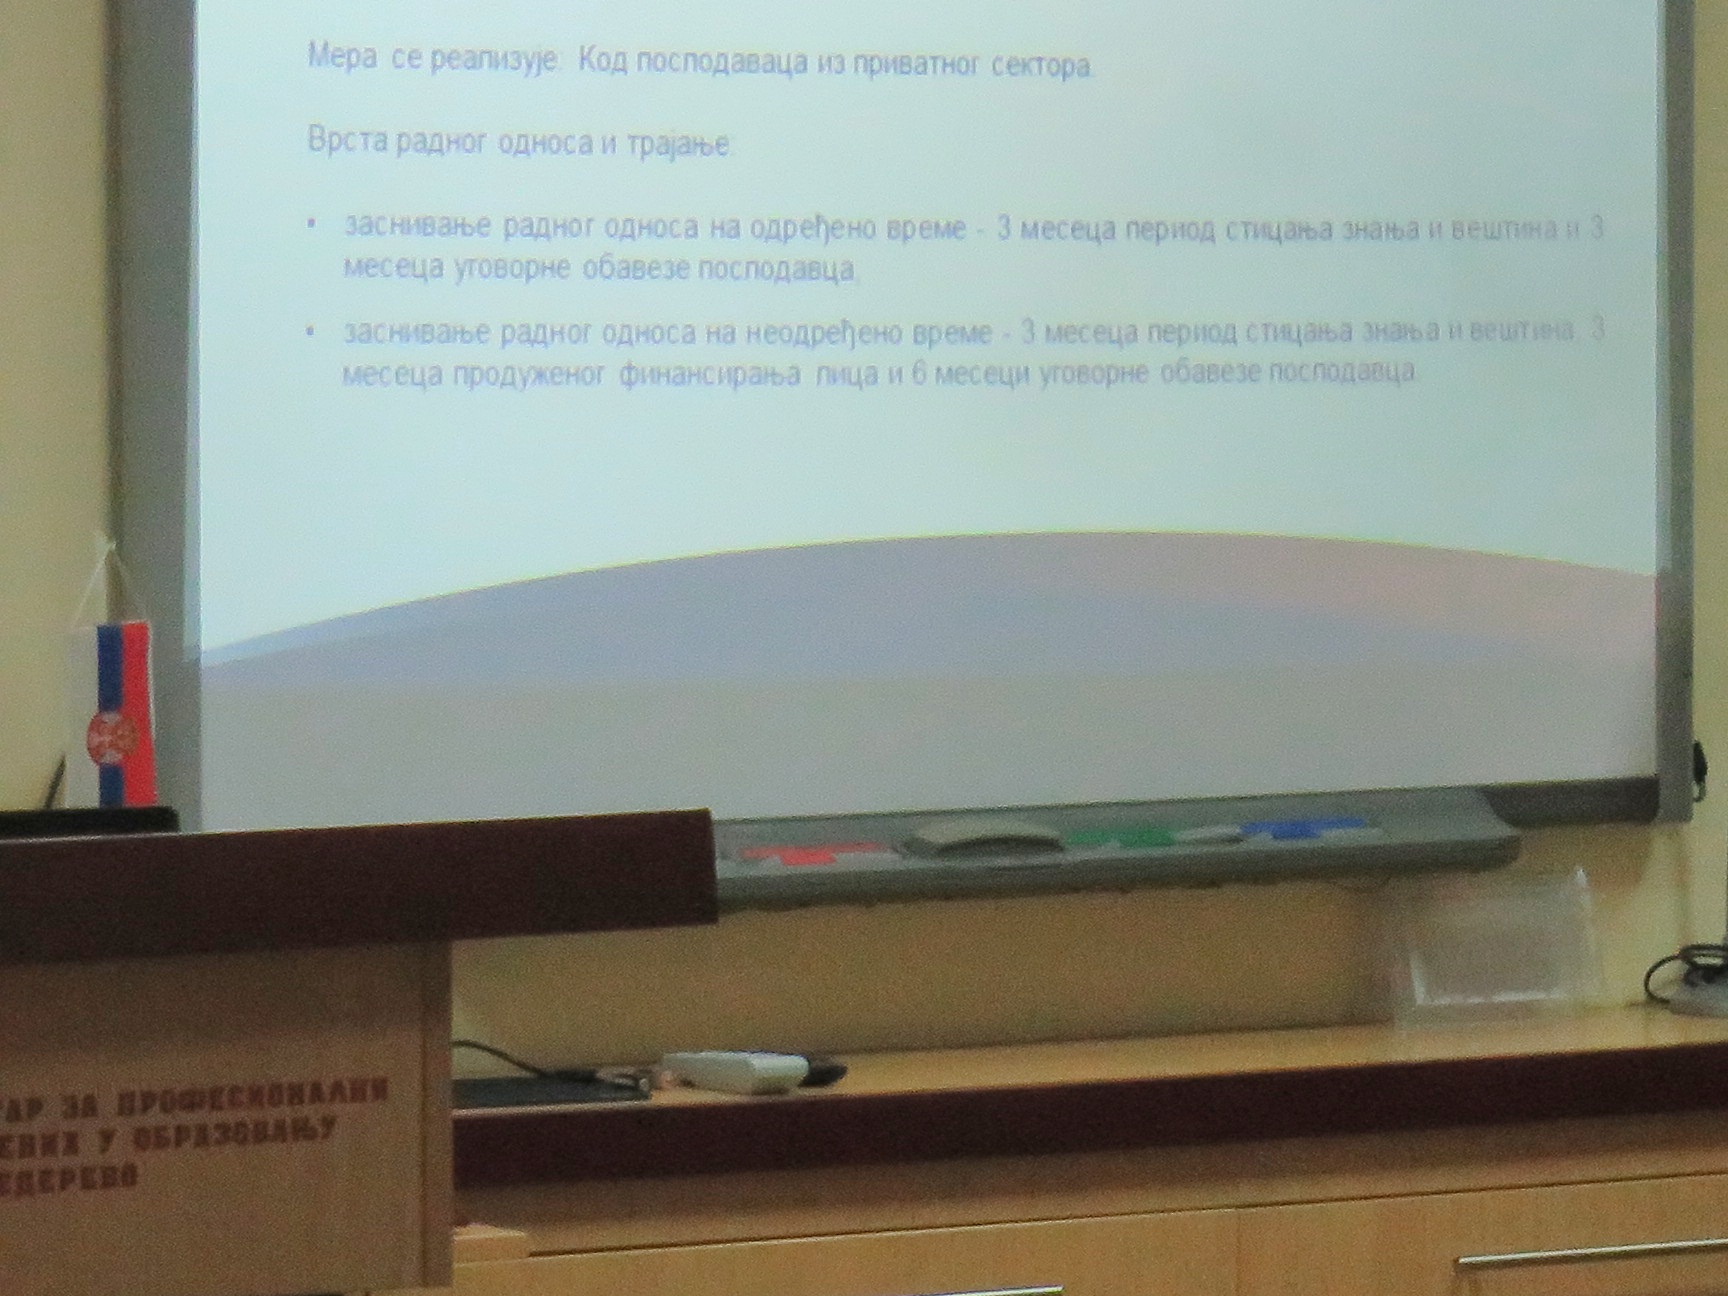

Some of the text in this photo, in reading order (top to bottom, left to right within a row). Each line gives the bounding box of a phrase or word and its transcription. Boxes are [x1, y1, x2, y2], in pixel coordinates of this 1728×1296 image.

[308, 39, 377, 73] Мера
[392, 48, 422, 69] се
[579, 44, 628, 76] Код
[818, 53, 845, 75] из
[854, 54, 980, 81] приватног
[308, 123, 388, 158] Врста
[397, 132, 486, 158] радног
[499, 133, 593, 157] односа
[601, 135, 616, 154] и
[346, 215, 491, 236] заснивање
[504, 217, 594, 241] радног
[605, 217, 698, 241] односа
[711, 218, 740, 239] на
[751, 212, 876, 245] одређено
[887, 219, 966, 245] време
[998, 214, 1011, 240] 3
[1021, 220, 1116, 246] месеца
[1126, 220, 1216, 246] период
[1226, 220, 1333, 246] стицања
[1343, 220, 1419, 241] знања
[1429, 221, 1442, 239] и
[1592, 214, 1604, 239] 3
[344, 257, 444, 283] месеца
[455, 258, 570, 285] уговорне
[583, 252, 690, 280] обавезе
[345, 323, 490, 343] заснивање
[501, 323, 592, 349] радног
[602, 324, 696, 347] односа
[706, 324, 736, 344] на
[747, 318, 903, 350] неодређено
[913, 324, 992, 350] време
[1022, 317, 1035, 343] 3
[1045, 324, 1138, 348] месеца
[1148, 323, 1237, 347] период
[343, 365, 443, 392] месеца
[454, 365, 604, 391] продуженог
[619, 360, 801, 391] финансирања
[889, 367, 903, 384] и
[912, 359, 927, 385] 6
[936, 365, 1029, 390] месеци
[1039, 364, 1149, 390] уговорне
[1161, 357, 1261, 384] обавезе
